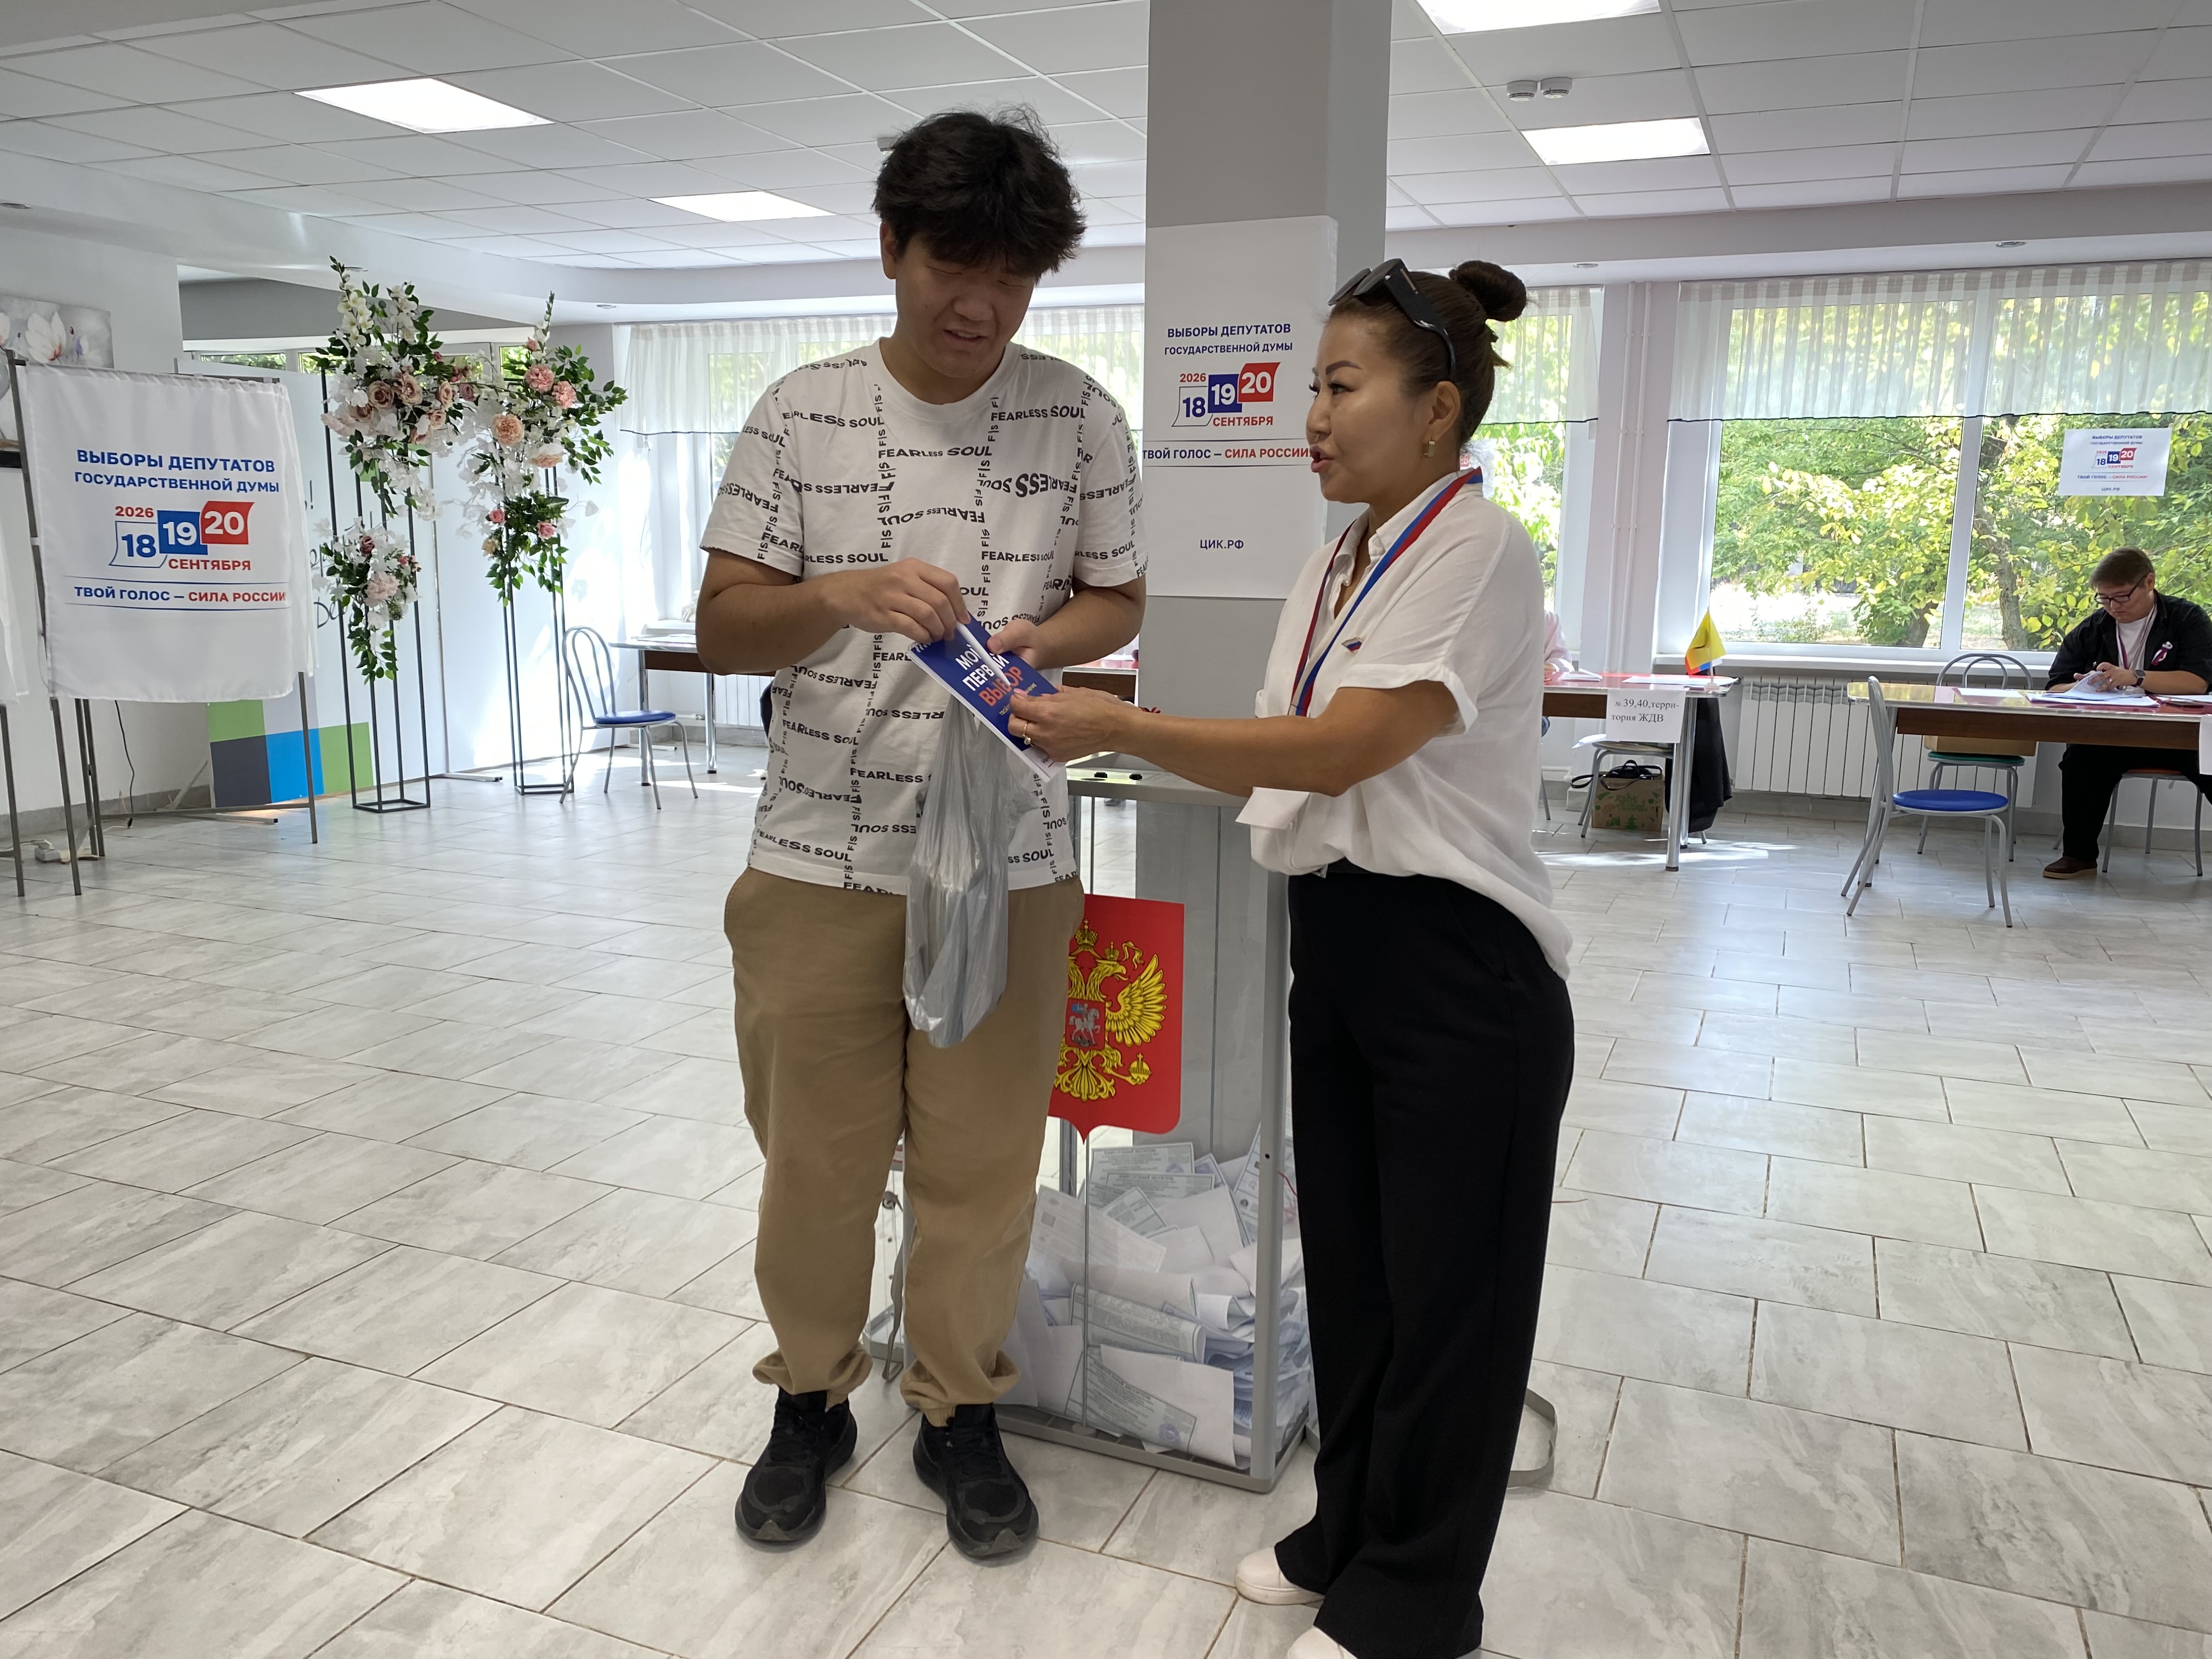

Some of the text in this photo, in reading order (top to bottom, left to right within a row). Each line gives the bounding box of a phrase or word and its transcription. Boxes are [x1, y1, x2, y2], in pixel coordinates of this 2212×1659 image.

[1167, 323, 1291, 338] ВЫБОРЫ ДЕПУТАТОВ
[1164, 341, 1293, 356] ГОСУДАРСТВЕННОЙ ДУМЫ
[1180, 373, 1206, 383] 2026
[1241, 371, 1272, 393] 20
[1211, 383, 1235, 405] 19
[991, 405, 1086, 421] FEARLESS SOUL
[1182, 397, 1206, 417] 18
[849, 416, 884, 428] SOUL
[1212, 416, 1273, 427] СЕНТЯБРЯ
[878, 445, 992, 459] FEARLESS SOUL
[1173, 449, 1211, 459] ГОЛОС
[1224, 448, 1256, 459] СИЛА
[2108, 454, 2119, 462] 19
[2120, 450, 2134, 459] 20
[76, 450, 275, 472] ВЫБОРЫ ДЕПУТАТОВ
[75, 471, 279, 493] ГОСУДАРСТВЕННОЙ ДУМЫ
[977, 473, 1077, 498] FEARLESS SOUL
[115, 505, 154, 518] 2026
[877, 507, 985, 526] FEARLESS SOUL
[204, 511, 245, 535] 20
[162, 521, 198, 546] 19
[121, 533, 156, 558] 18
[1111, 540, 1136, 557] SOUL
[1200, 539, 1244, 550] ЦИК.РФ
[847, 552, 889, 563] SOUL
[981, 550, 1054, 562] FEARLESS SOUL
[168, 558, 251, 571] СЕНТЯБРЯ
[74, 586, 115, 600] ТВОЙ
[120, 589, 170, 601] ГОЛОС
[188, 591, 229, 602] СИЛА
[233, 591, 286, 602] РОССИИ
[981, 617, 1008, 630] SOU
[790, 665, 877, 689] FEARLESS SOUL
[962, 652, 1010, 691] ПЕРВЙ
[1639, 713, 1664, 723] ЖДВ
[783, 719, 830, 741] FEARLESS
[850, 768, 923, 783] FEARLESS
[851, 823, 889, 833] SOUL
[1043, 817, 1067, 830] SOUL
[814, 848, 852, 862] SOUL
[1023, 849, 1054, 862] SOUL
